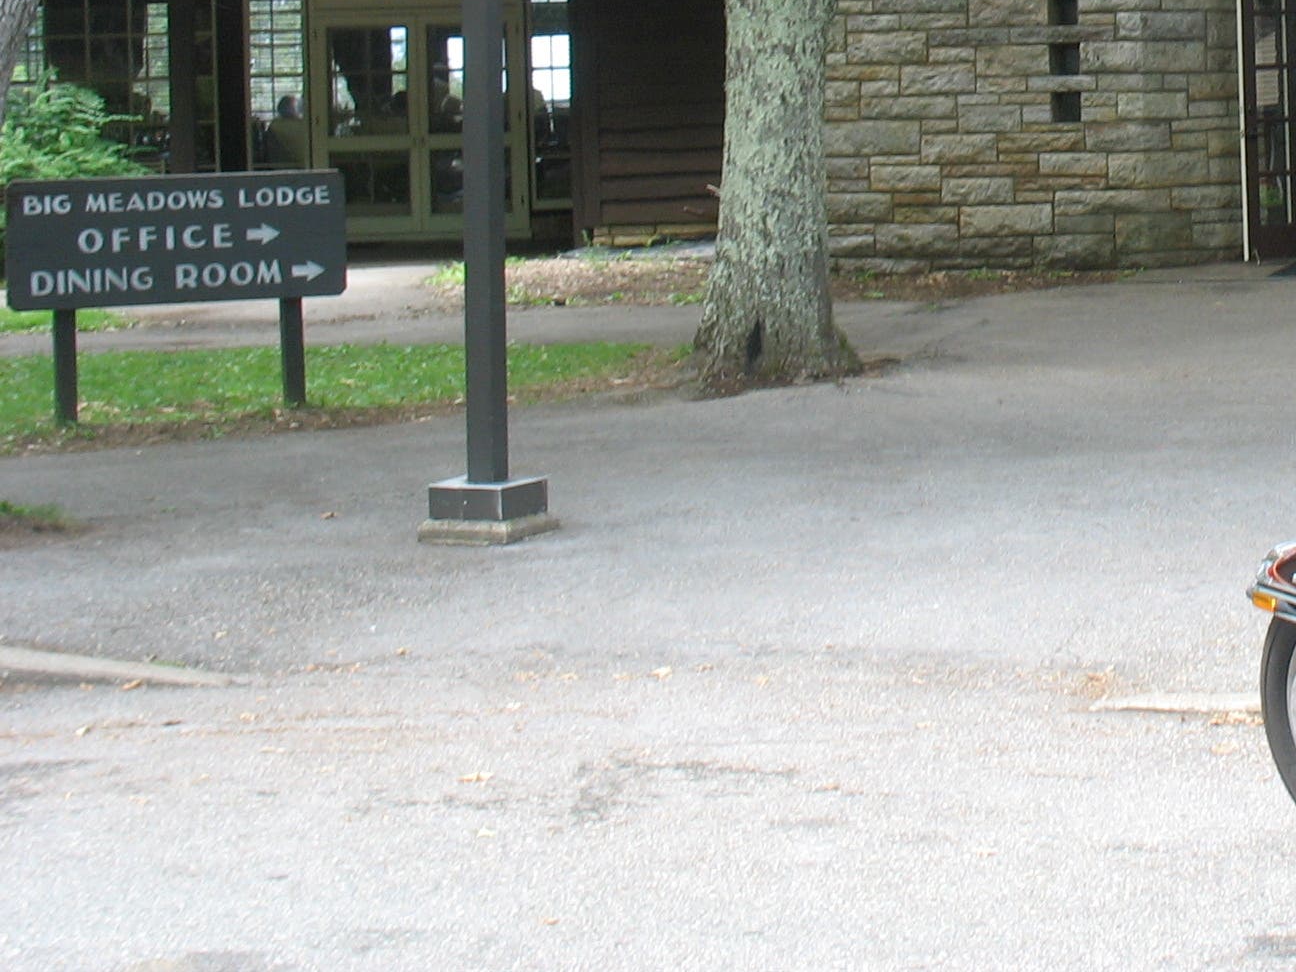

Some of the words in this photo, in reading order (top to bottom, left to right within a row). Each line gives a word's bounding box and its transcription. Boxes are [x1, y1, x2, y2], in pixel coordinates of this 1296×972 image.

[22, 193, 72, 216] BIG
[85, 188, 225, 213] MEADOWS
[238, 185, 331, 208] LODGE
[77, 223, 234, 254] OFFICE
[29, 266, 154, 297] DINING
[175, 259, 283, 290] ROOM
